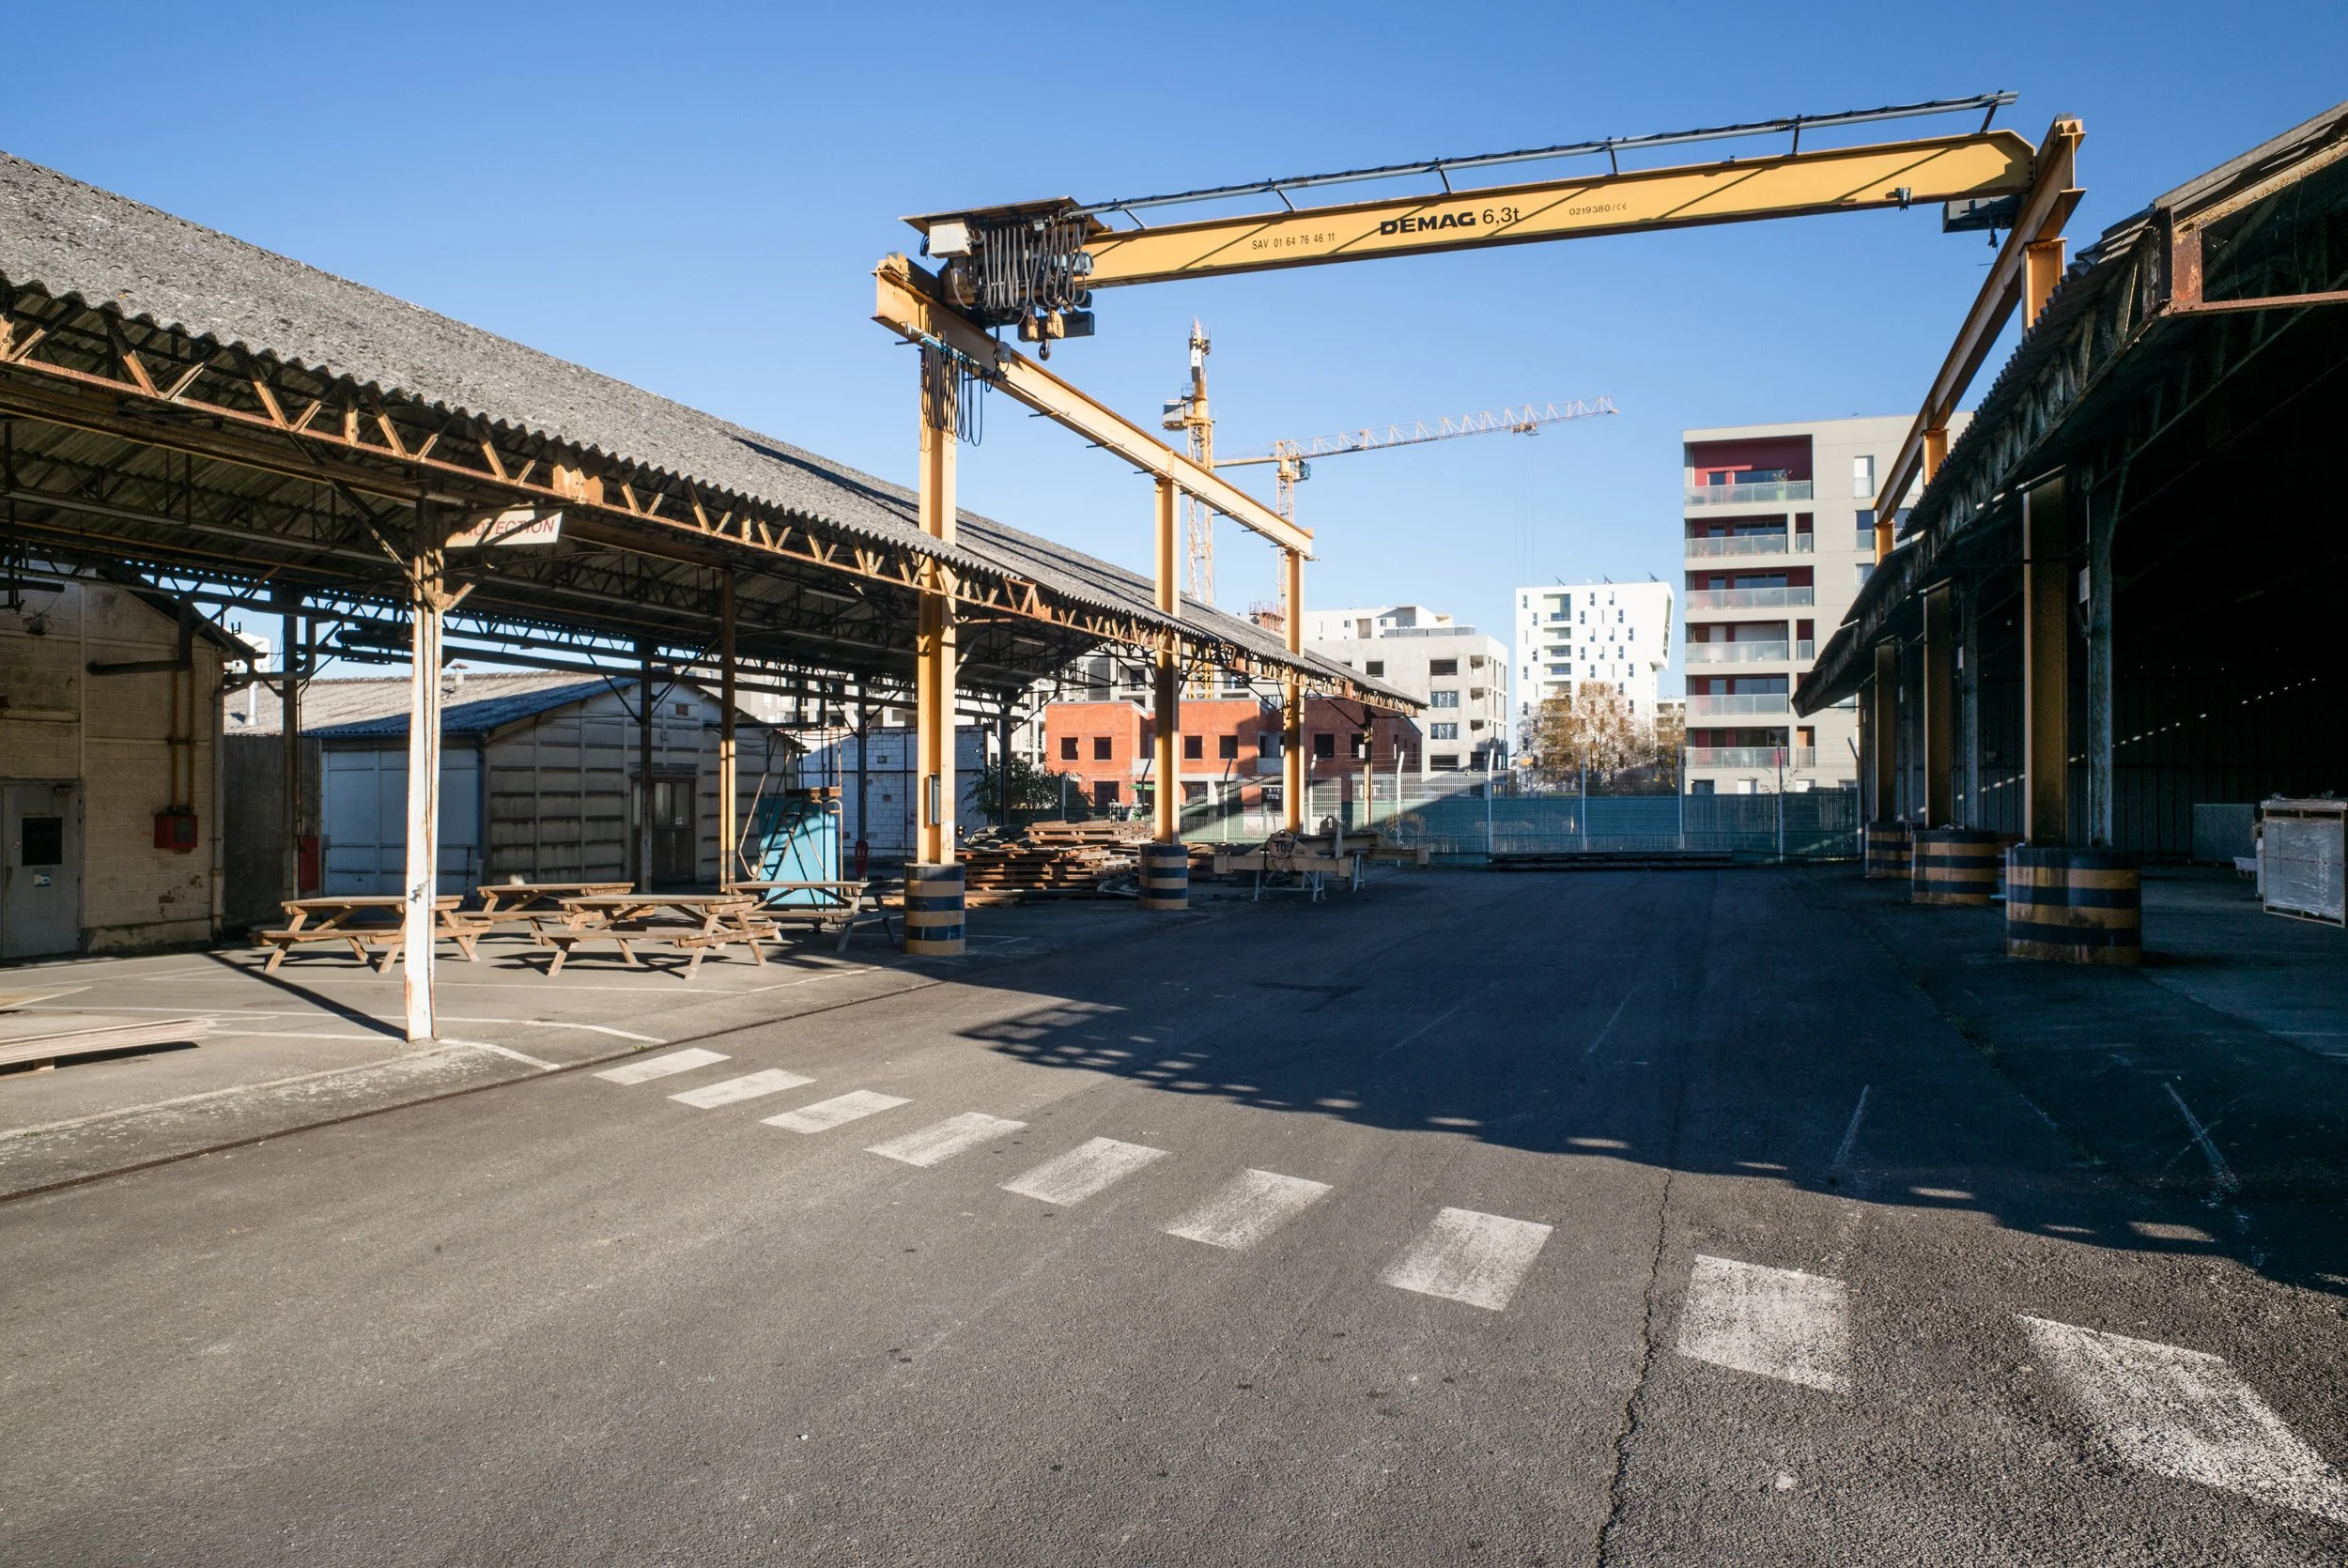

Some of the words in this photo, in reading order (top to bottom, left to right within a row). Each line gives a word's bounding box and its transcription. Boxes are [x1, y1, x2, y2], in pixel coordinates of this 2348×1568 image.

[1380, 211, 1476, 236] DEMAG
[1482, 207, 1521, 227] 6,3t
[1252, 238, 1269, 250] SAV
[1274, 238, 1282, 248] 01
[1286, 237, 1296, 246] 64
[1300, 235, 1309, 244] 76
[1313, 233, 1323, 243] 46
[1327, 232, 1335, 241] 11
